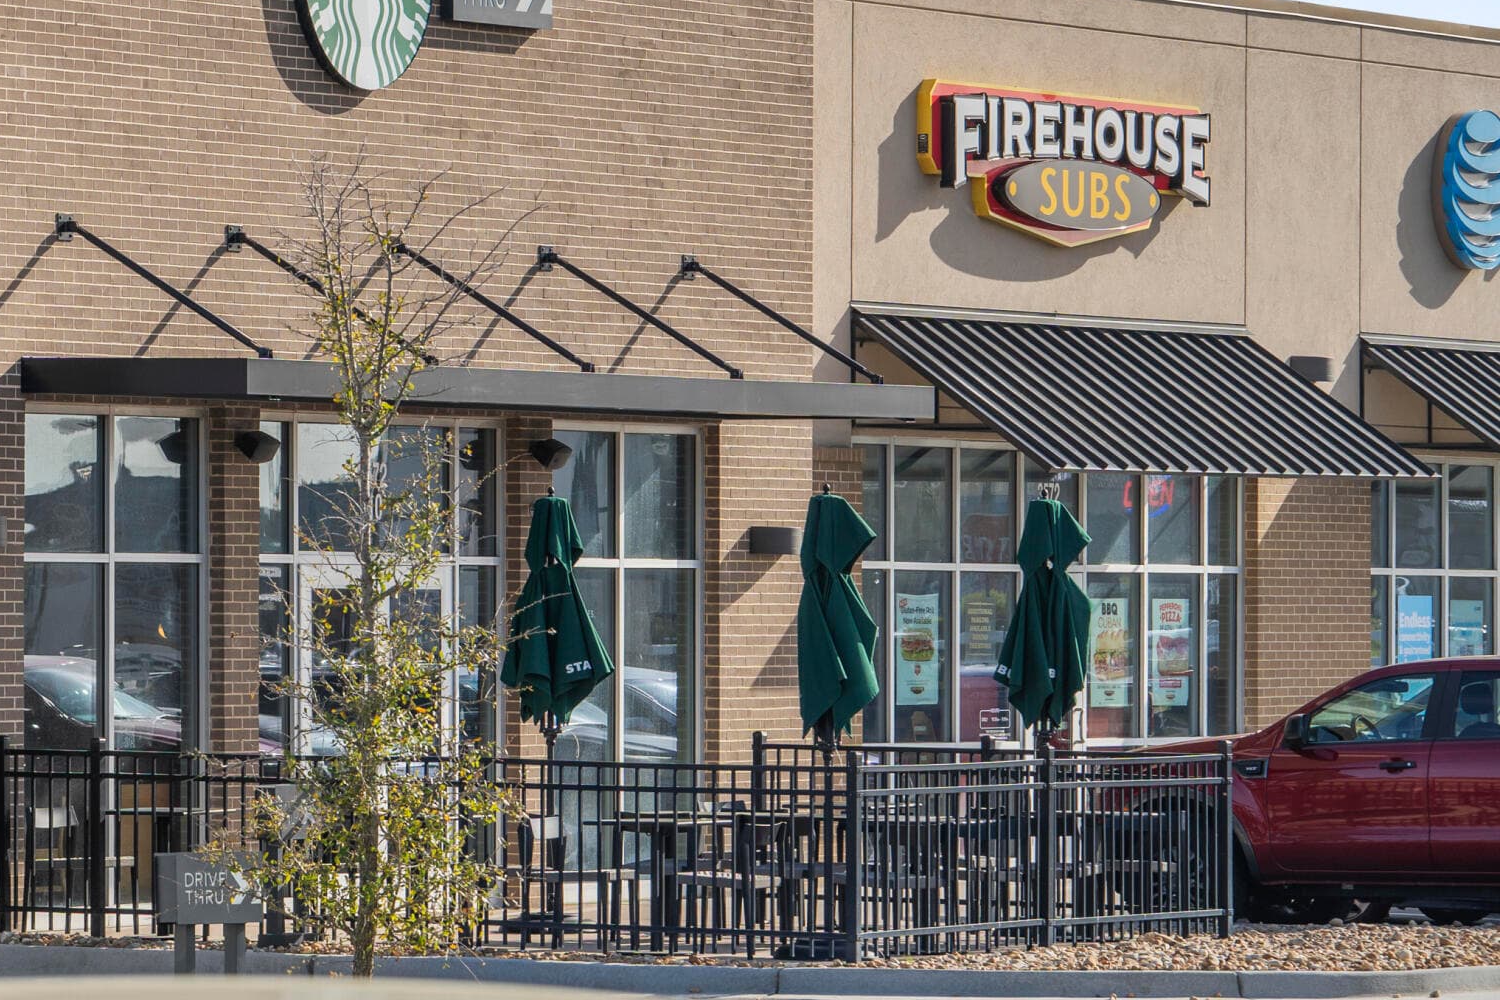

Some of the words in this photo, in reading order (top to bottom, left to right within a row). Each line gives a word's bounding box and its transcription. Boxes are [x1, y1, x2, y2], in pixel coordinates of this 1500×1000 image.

[946, 92, 1211, 206] FIREHOUSE
[1039, 167, 1131, 222] SUBS
[1101, 602, 1119, 616] BBQ
[1399, 612, 1431, 628] Endless
[184, 889, 224, 905] THRU
